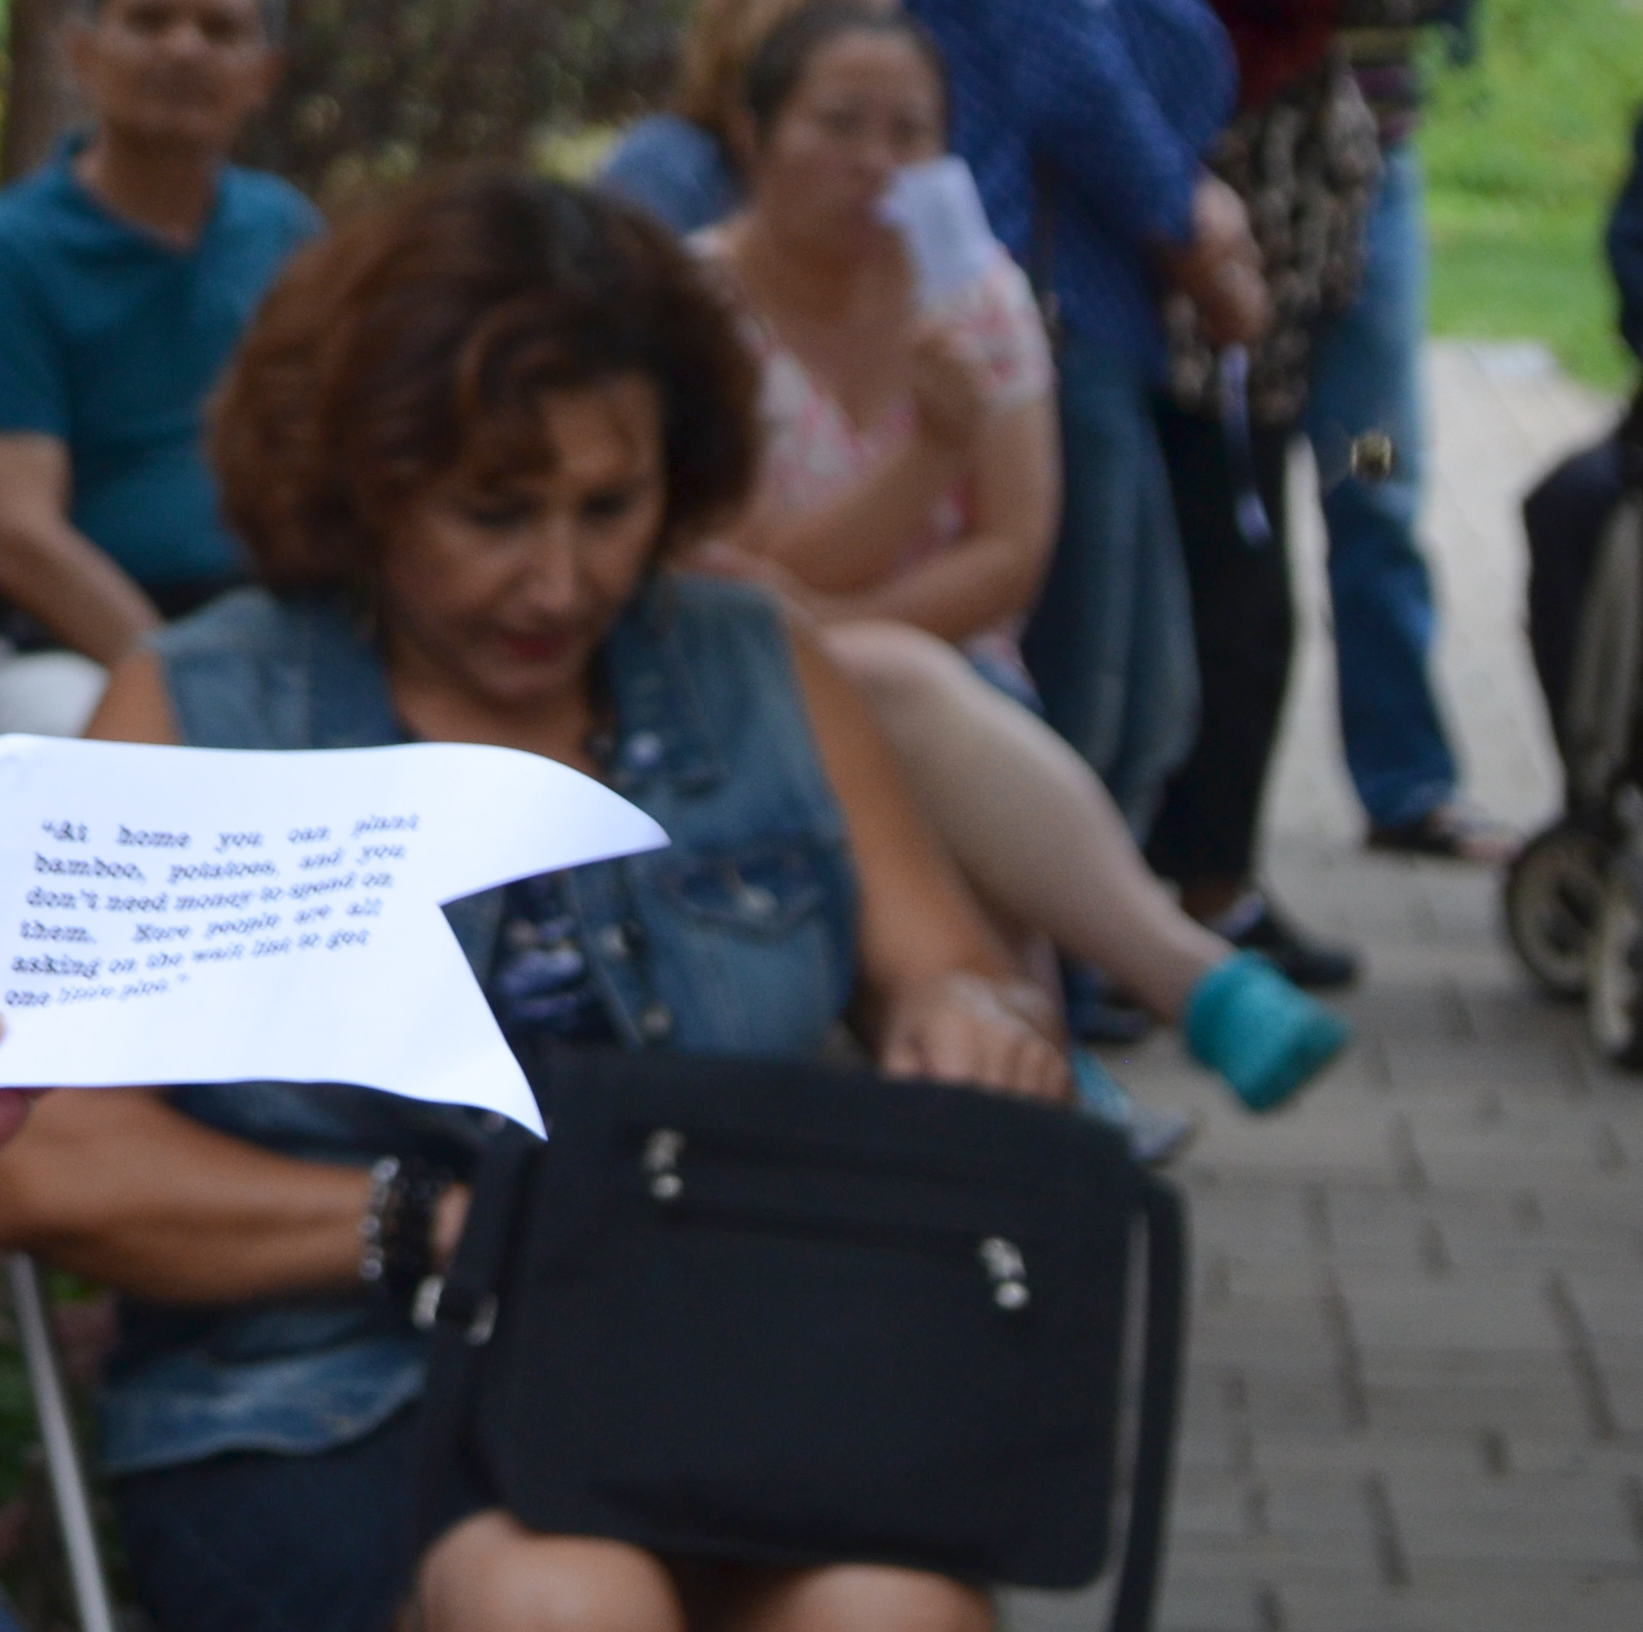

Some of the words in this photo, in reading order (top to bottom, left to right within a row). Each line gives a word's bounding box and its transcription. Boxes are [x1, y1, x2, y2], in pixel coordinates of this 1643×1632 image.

[116, 823, 192, 848] home
[214, 830, 263, 854] you
[287, 825, 331, 844] can
[351, 813, 420, 838] plant
[34, 852, 146, 883] bamboo,
[300, 846, 344, 869] and
[356, 843, 407, 865] you
[105, 891, 169, 912] need
[173, 890, 253, 911] money
[259, 885, 283, 902] to
[287, 870, 357, 900] spend
[362, 871, 393, 888] on
[19, 920, 97, 944] them.
[204, 911, 281, 939] people
[294, 904, 332, 925] are
[346, 896, 382, 917] all
[11, 954, 102, 979] asking
[108, 958, 138, 974] on
[146, 951, 183, 968] the
[298, 931, 320, 949] to
[326, 927, 369, 951] get
[4, 989, 50, 1007] one
